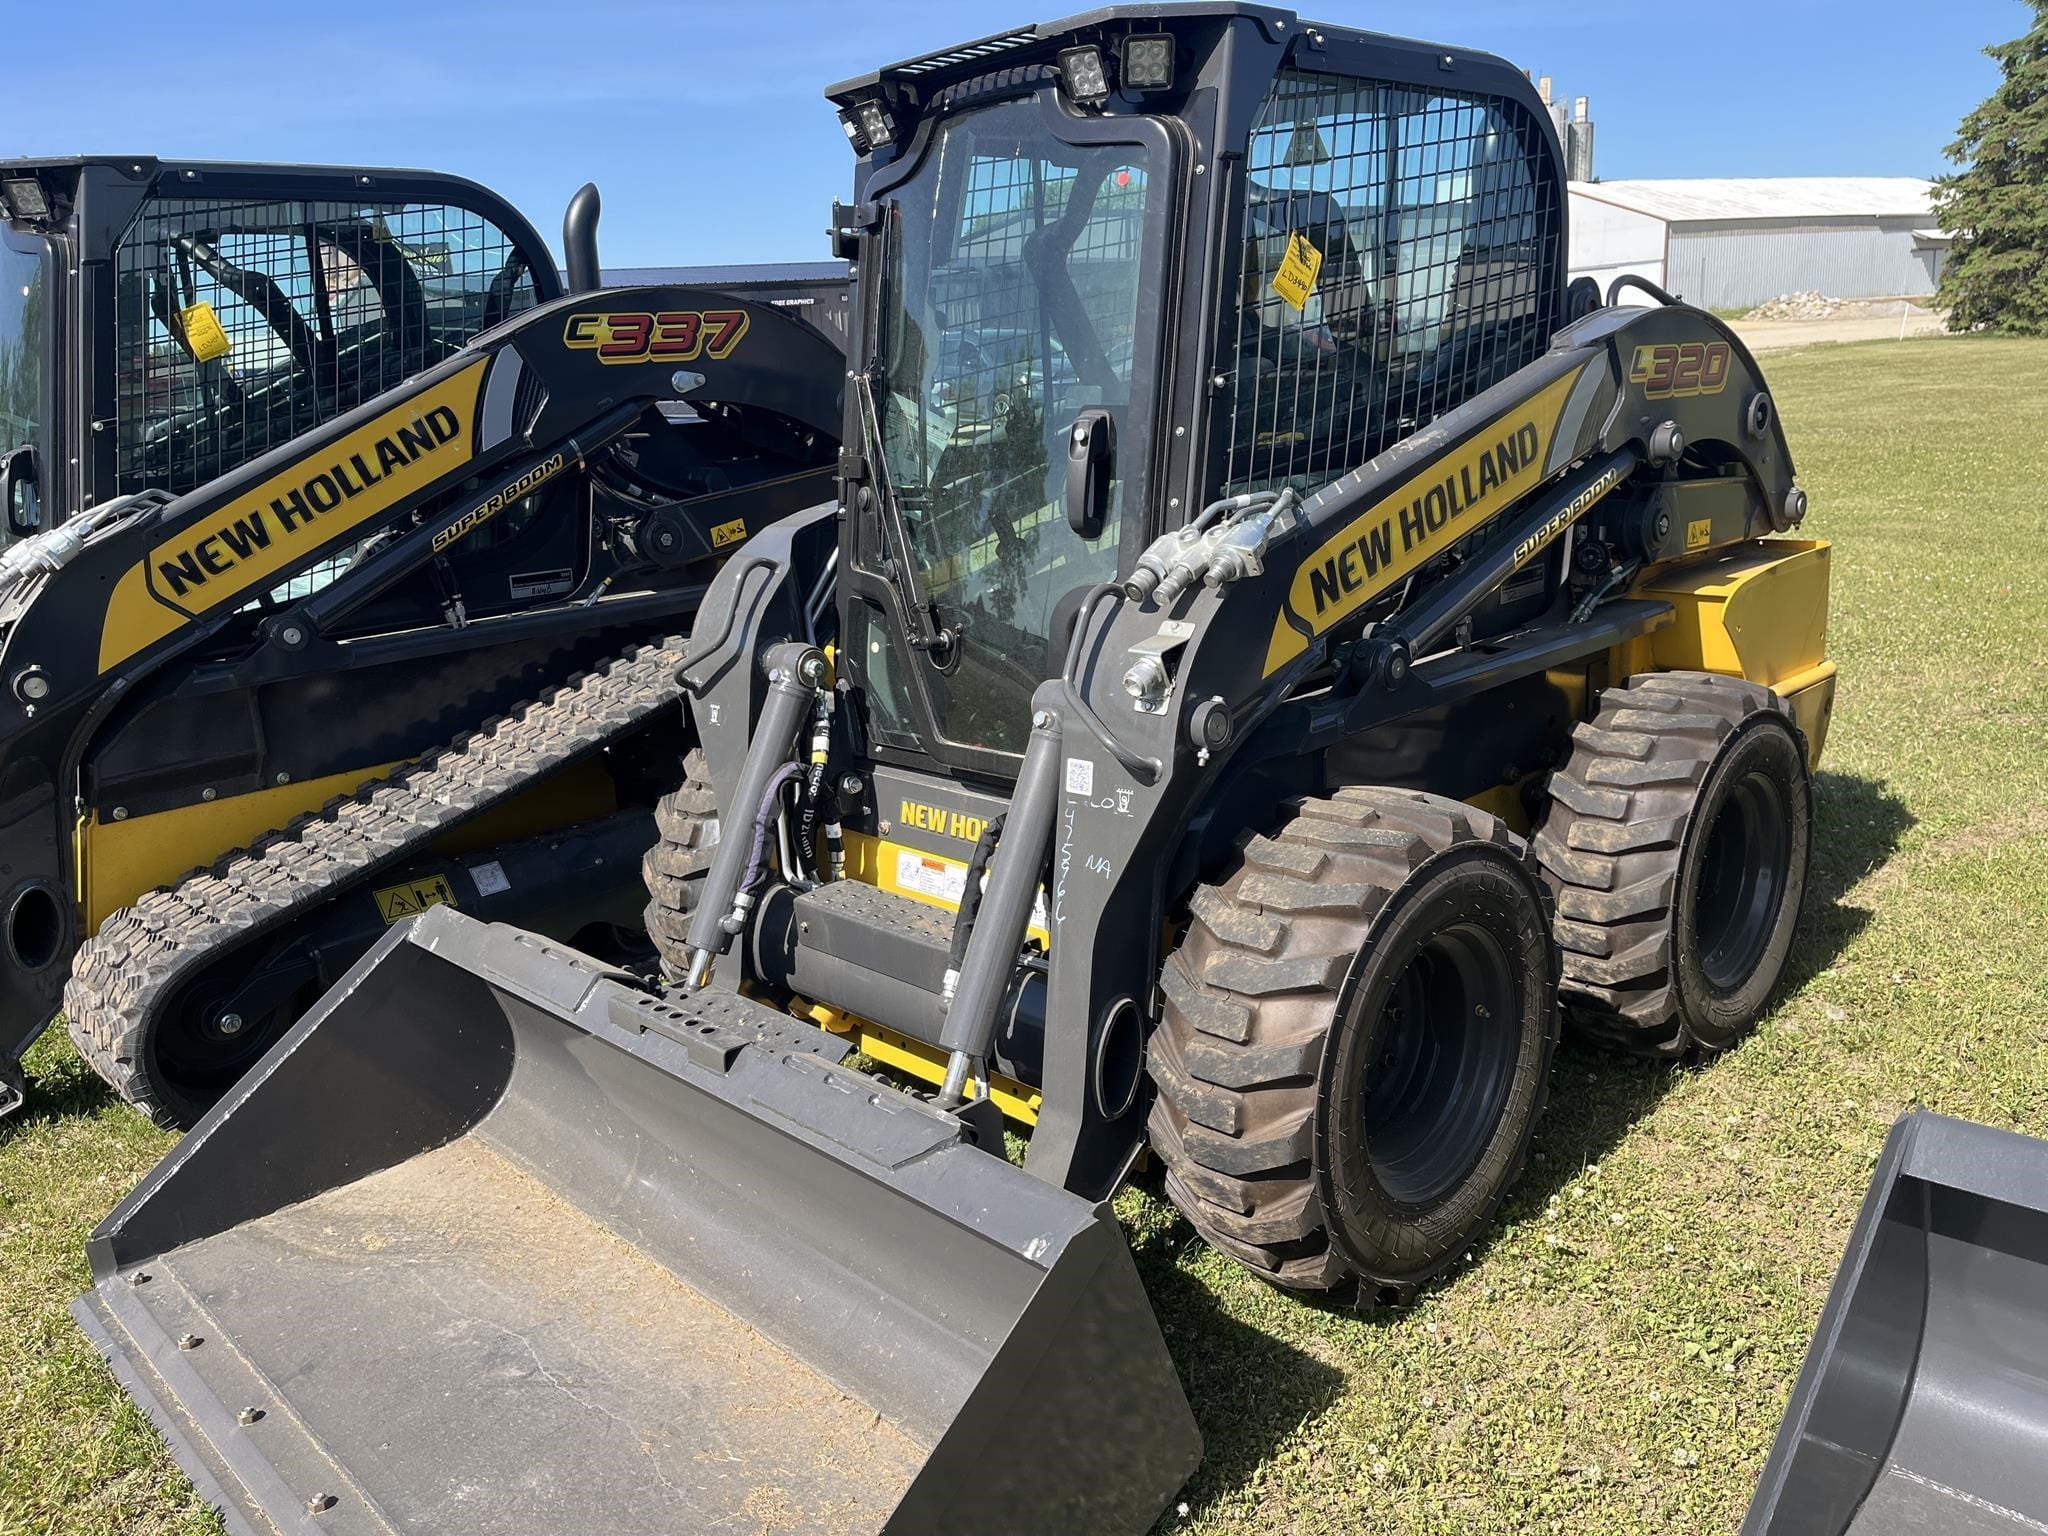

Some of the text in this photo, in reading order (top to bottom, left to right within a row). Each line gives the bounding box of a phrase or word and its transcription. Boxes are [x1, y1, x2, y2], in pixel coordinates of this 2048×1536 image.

[565, 311, 748, 363] C337
[1630, 342, 1731, 398] L320
[157, 404, 461, 597] NEW HOLLAND
[433, 454, 562, 550] SUPER BOOM
[1309, 421, 1538, 615] NEW HOLLAND
[1514, 468, 1617, 565] SUPER BOOM
[901, 800, 948, 834] NEW
